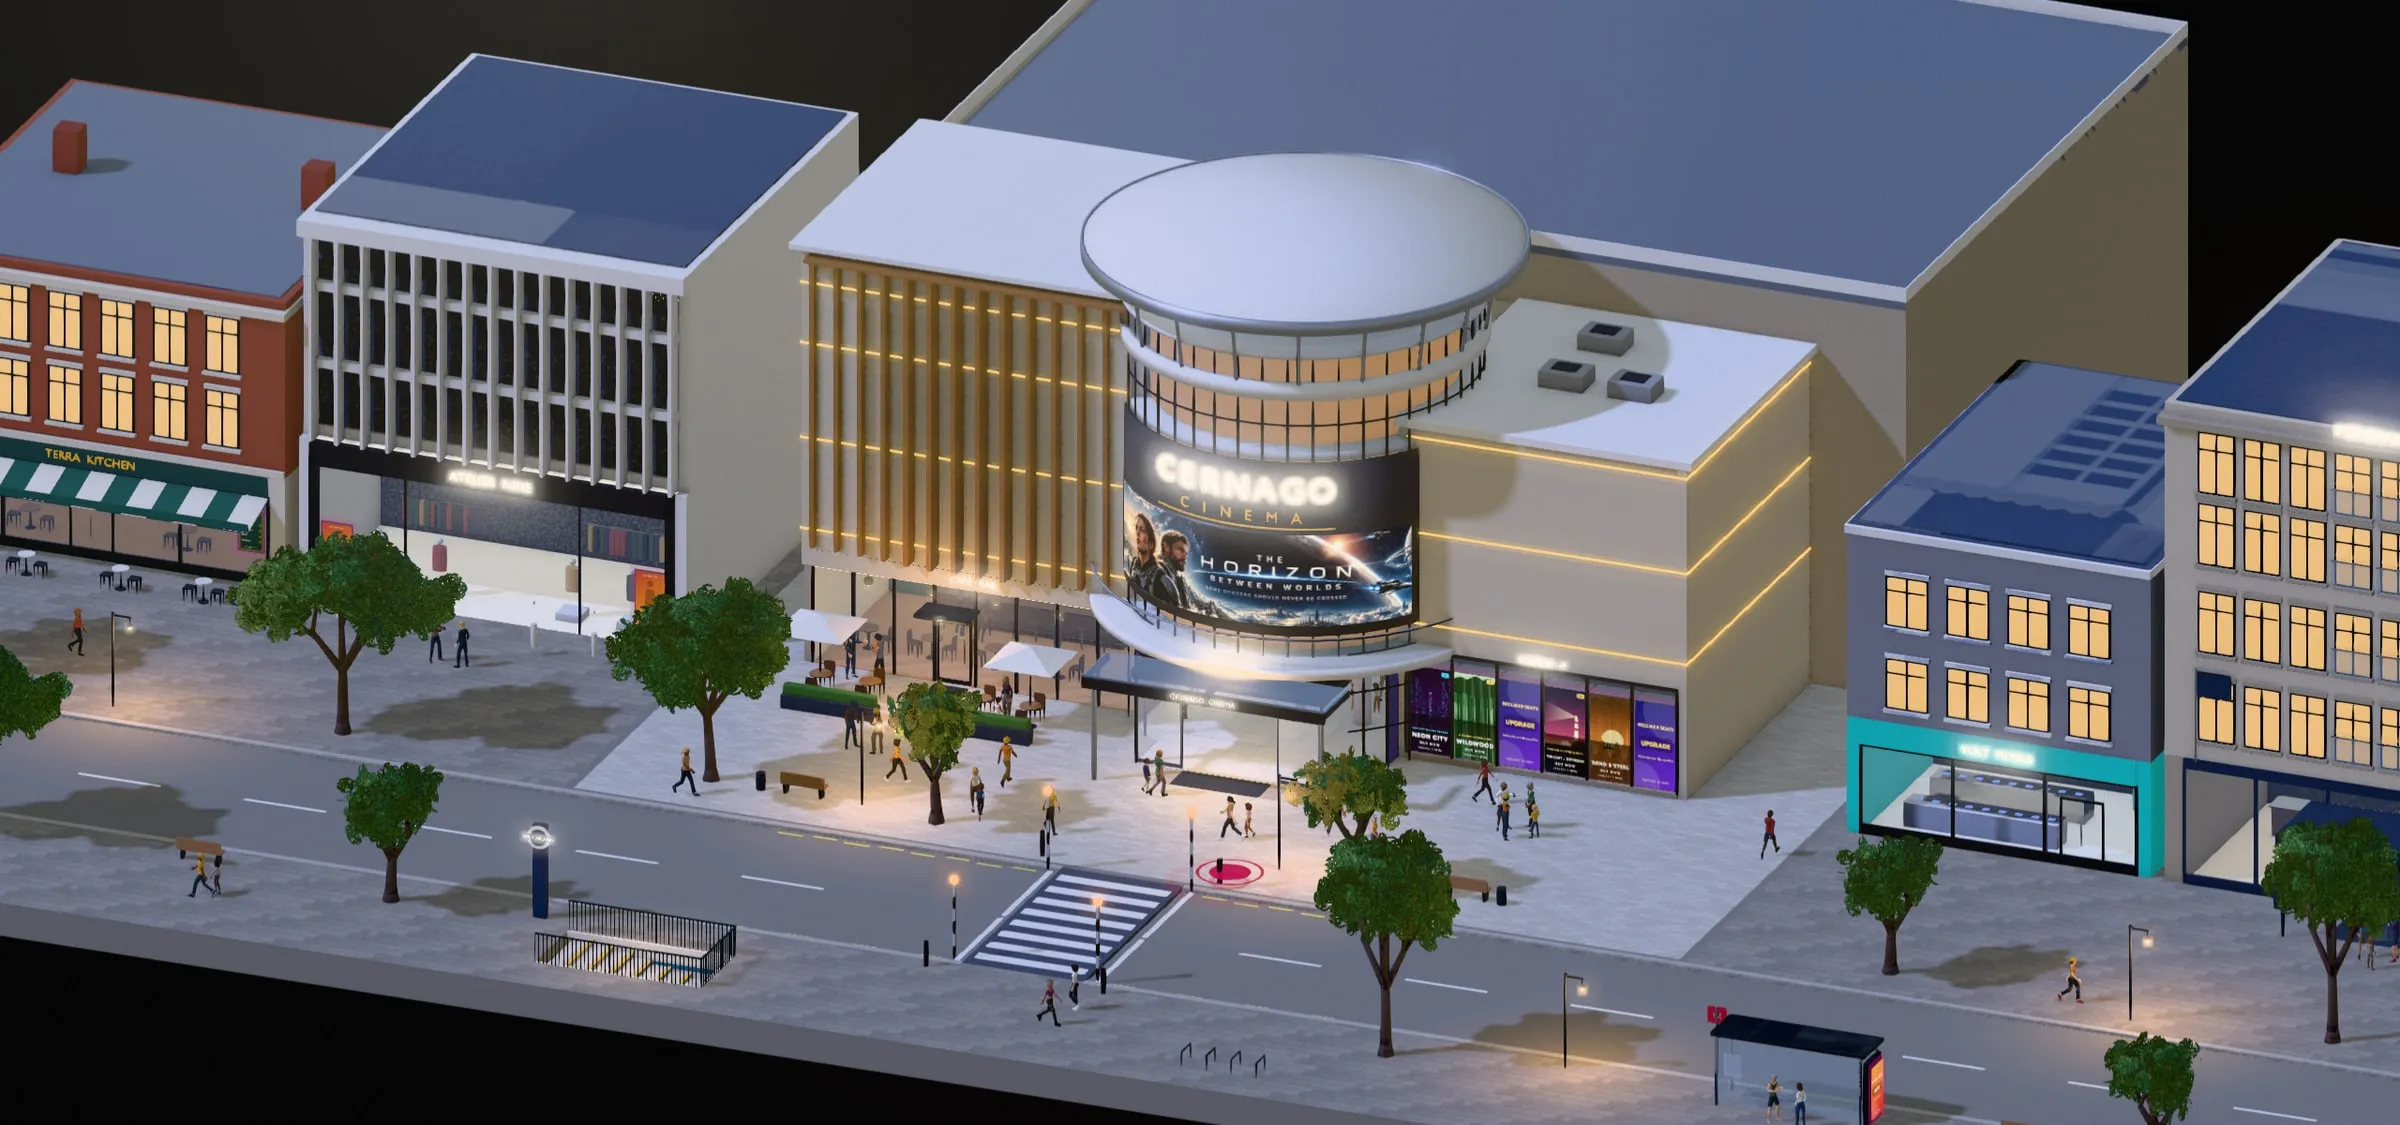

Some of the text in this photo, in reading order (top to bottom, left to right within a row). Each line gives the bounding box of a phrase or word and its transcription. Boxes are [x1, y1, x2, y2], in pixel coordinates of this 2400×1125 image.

[45, 447, 136, 471] TERRA KITCHEN
[1155, 452, 1338, 506] CERNAGO
[1180, 495, 1303, 525] CINEMA
[1256, 554, 1283, 564] THE
[1200, 554, 1353, 579] HORIZON
[1209, 574, 1342, 591] BETWEEN WORLDS
[1505, 719, 1535, 729] UPGRADE
[1411, 731, 1431, 740] NEON
[1432, 734, 1448, 743] CITY
[1456, 738, 1494, 749] WILDWOOD
[1640, 740, 1671, 750] UPGRADE
